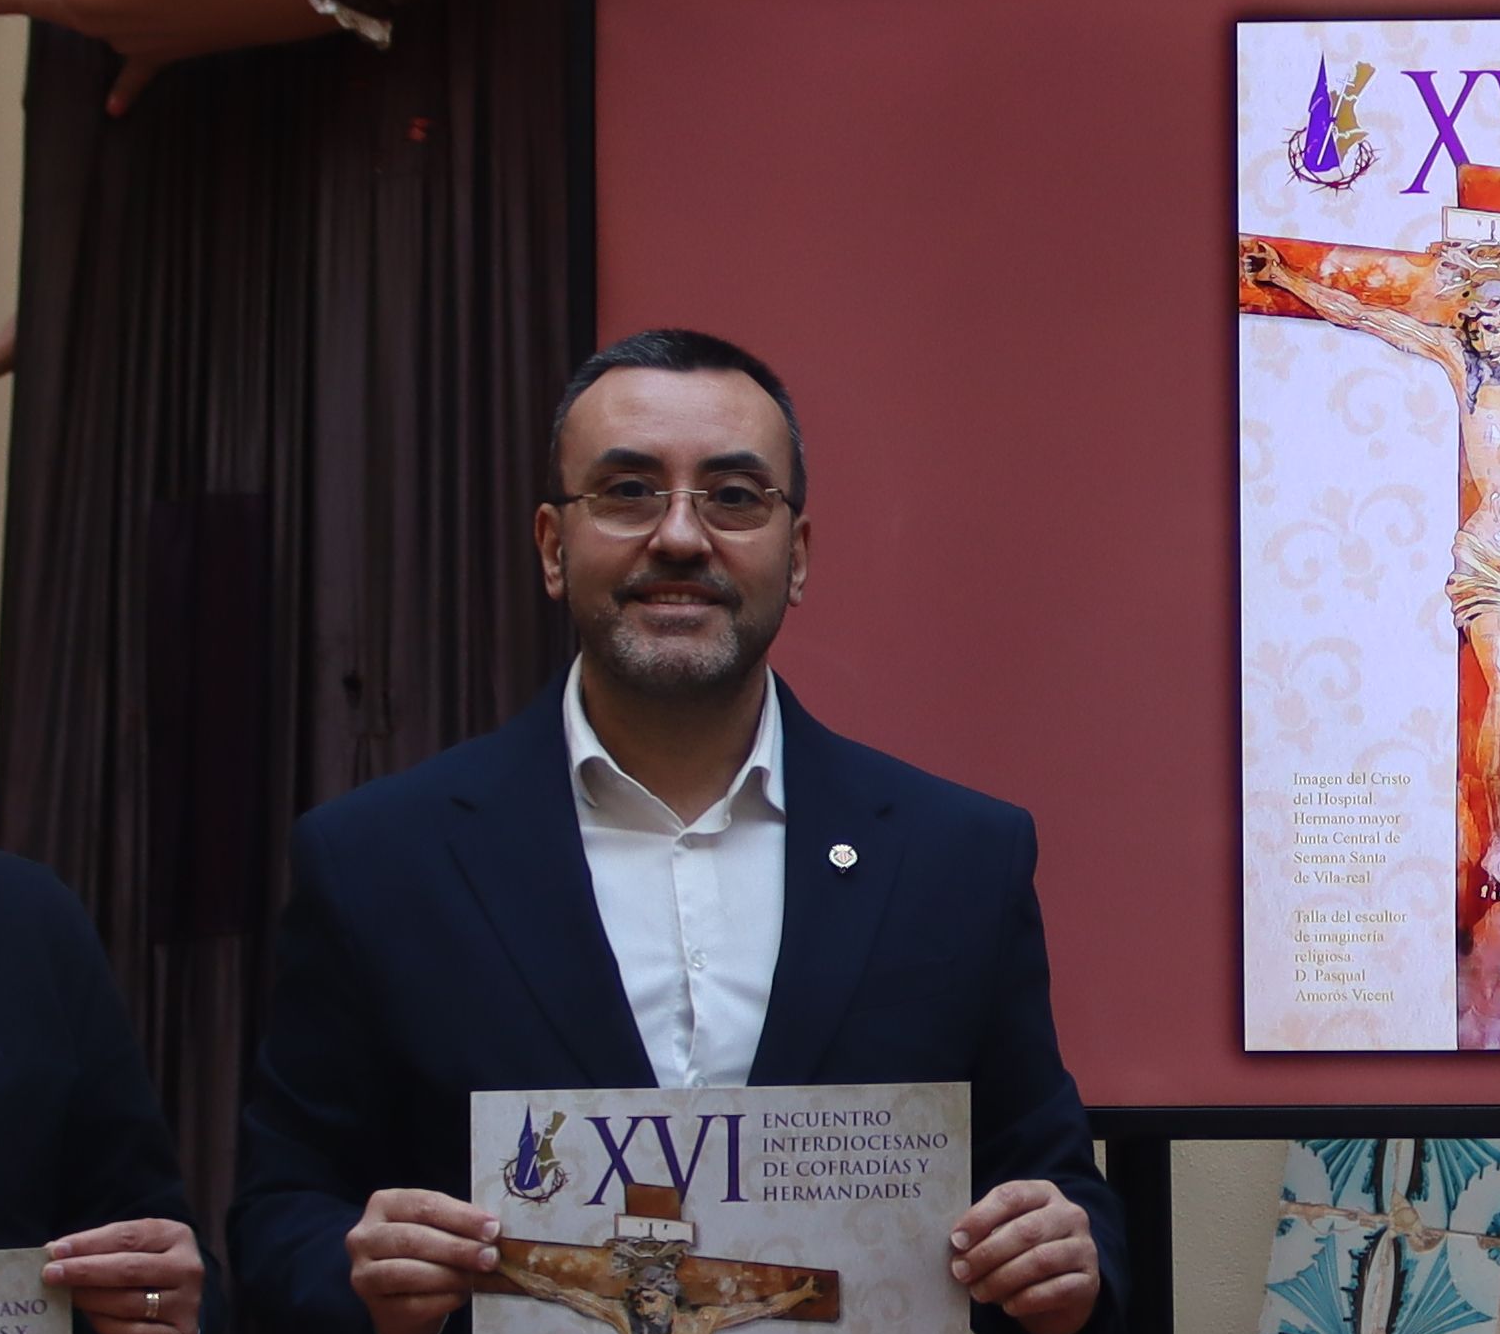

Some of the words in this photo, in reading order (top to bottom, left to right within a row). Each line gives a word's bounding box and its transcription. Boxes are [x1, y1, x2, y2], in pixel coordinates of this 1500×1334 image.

[1293, 772, 1342, 791] Imagen
[1346, 772, 1367, 786] del
[1371, 772, 1411, 786] Cristo
[1293, 792, 1313, 805] del
[1318, 792, 1376, 810] Hospital.
[1293, 812, 1355, 825] Hermano
[1358, 815, 1401, 829] mayor
[1293, 831, 1328, 845] Junta
[1333, 831, 1380, 844] Central
[1384, 831, 1400, 844] de
[1293, 851, 1346, 864] Semana
[1349, 851, 1386, 864] Santa
[1293, 871, 1309, 884] de
[1314, 870, 1370, 884] Vila-real
[1294, 911, 1327, 924] Talla
[1330, 910, 1351, 923] del
[1355, 910, 1407, 923] escultor
[1294, 930, 1310, 943] de
[1314, 929, 1384, 947] imaginería
[1294, 950, 1354, 966] religiosa.
[1295, 970, 1310, 982] D.
[1315, 969, 1366, 986] Pasqual
[1295, 988, 1347, 1002] Amorós
[1352, 988, 1395, 1002] Vicent
[763, 1111, 891, 1128] ENCUENTRO
[763, 1134, 948, 1152] INTERDIOCESANO
[585, 1116, 747, 1203] XVI
[763, 1161, 789, 1176] DE
[796, 1155, 913, 1176] COFRADÍAS
[916, 1159, 929, 1172] Y
[763, 1183, 921, 1201] HERMANDADES
